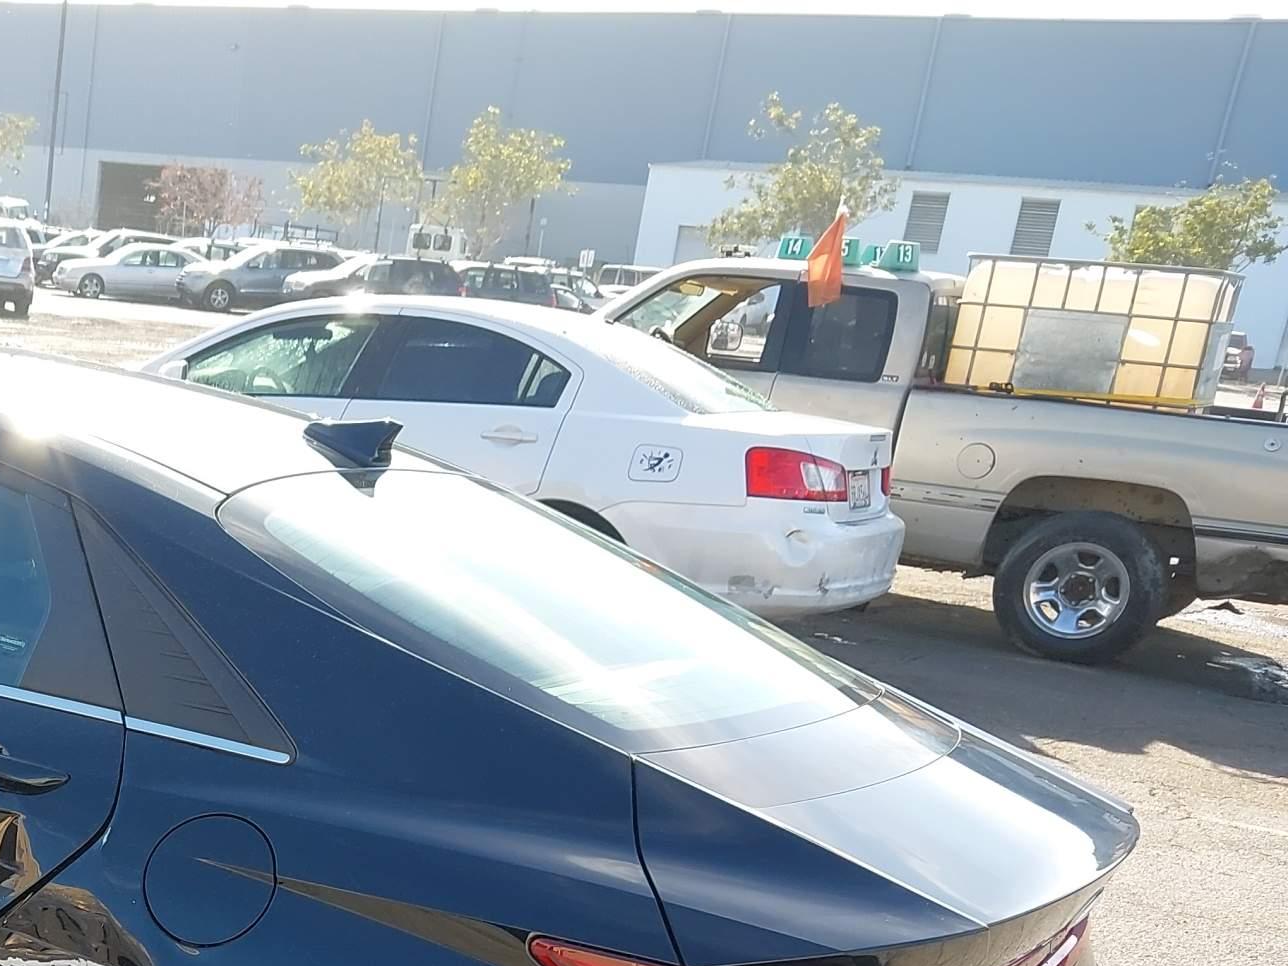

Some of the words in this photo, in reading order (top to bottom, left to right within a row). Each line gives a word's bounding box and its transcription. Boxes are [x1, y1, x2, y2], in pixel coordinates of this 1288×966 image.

[787, 239, 803, 255] 14
[841, 238, 850, 256] 5
[898, 244, 912, 263] 13
